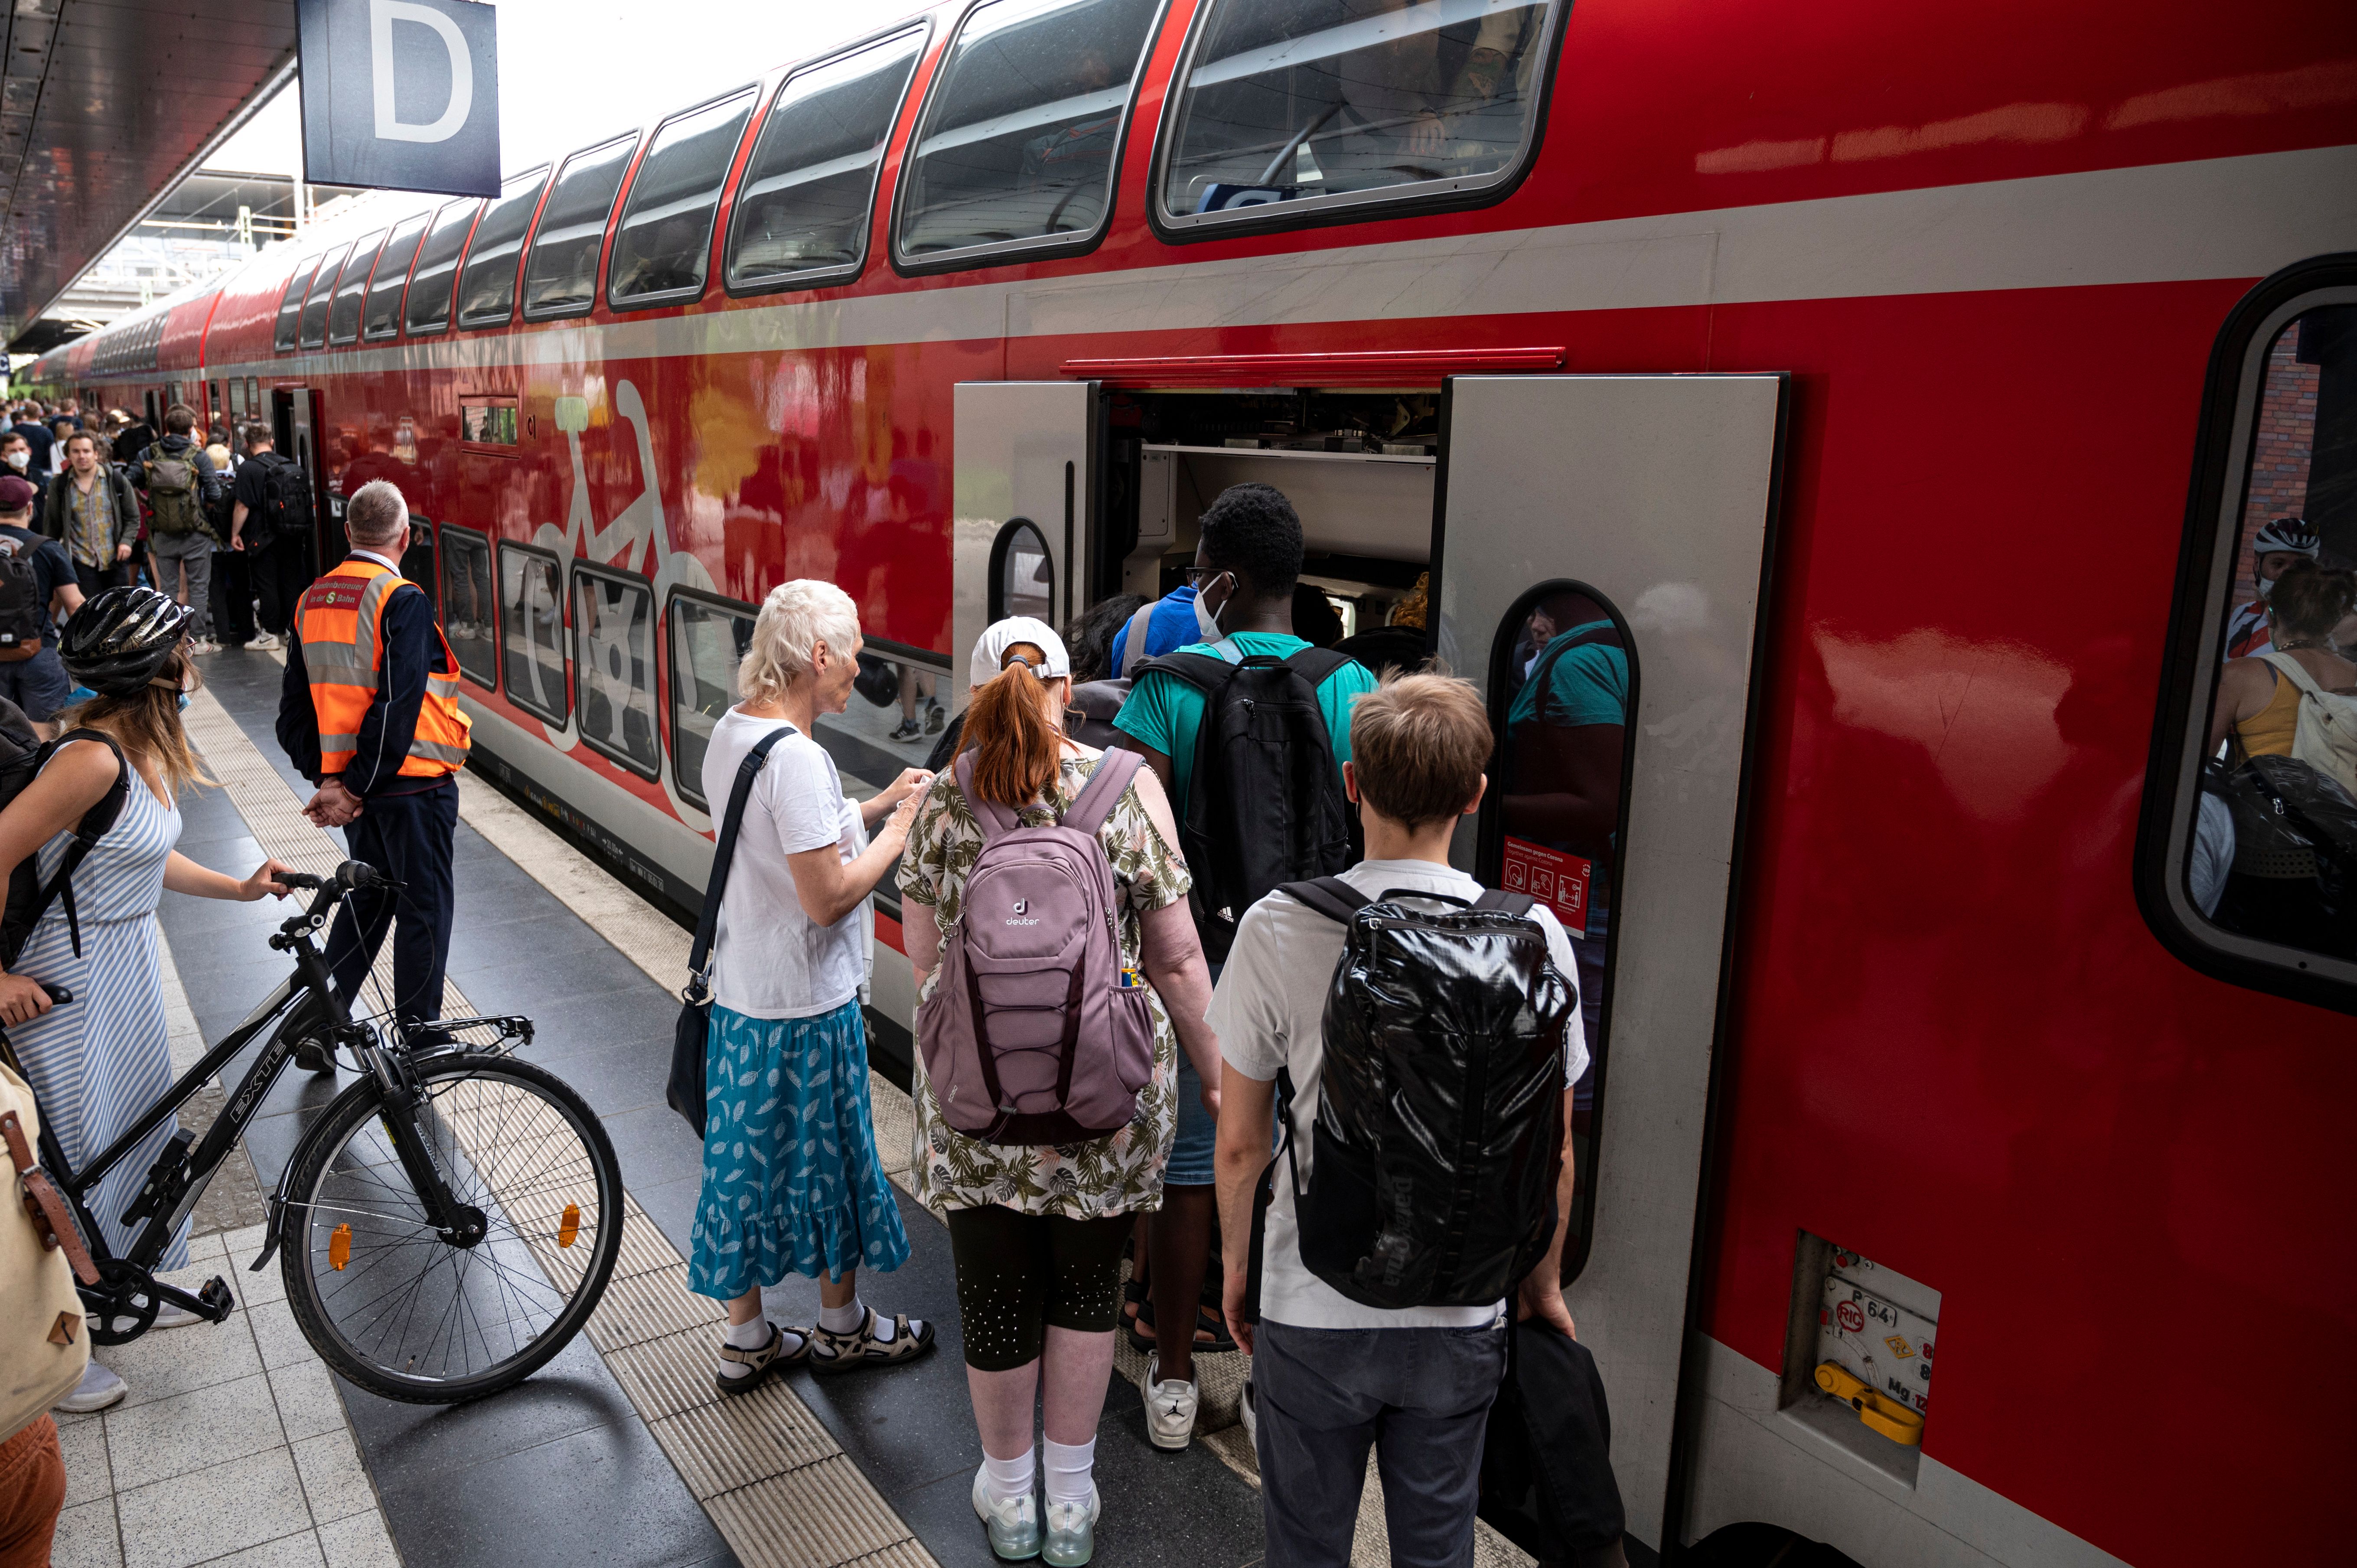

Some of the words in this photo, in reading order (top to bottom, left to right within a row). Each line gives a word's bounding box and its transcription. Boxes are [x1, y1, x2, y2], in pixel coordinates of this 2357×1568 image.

[370, 0, 473, 143] D
[313, 581, 364, 590] Kundenbetreuer
[326, 592, 336, 603] S
[337, 594, 355, 603] Bahn
[1507, 841, 1532, 854] Gemeinsam
[1532, 849, 1546, 858] gegen
[1547, 853, 1563, 862] Corona
[1507, 848, 1524, 858] Together
[1524, 853, 1538, 862] against
[1539, 857, 1553, 866] Corona
[1006, 917, 1040, 925] deuter
[1217, 912, 1234, 923] adidas
[229, 1039, 287, 1123] EXTE
[1382, 1176, 1414, 1287] patagonia
[1839, 1306, 1862, 1326] RIC
[1852, 1290, 1862, 1302] P
[1868, 1301, 1889, 1323] 64
[1888, 1377, 1910, 1402] Mg
